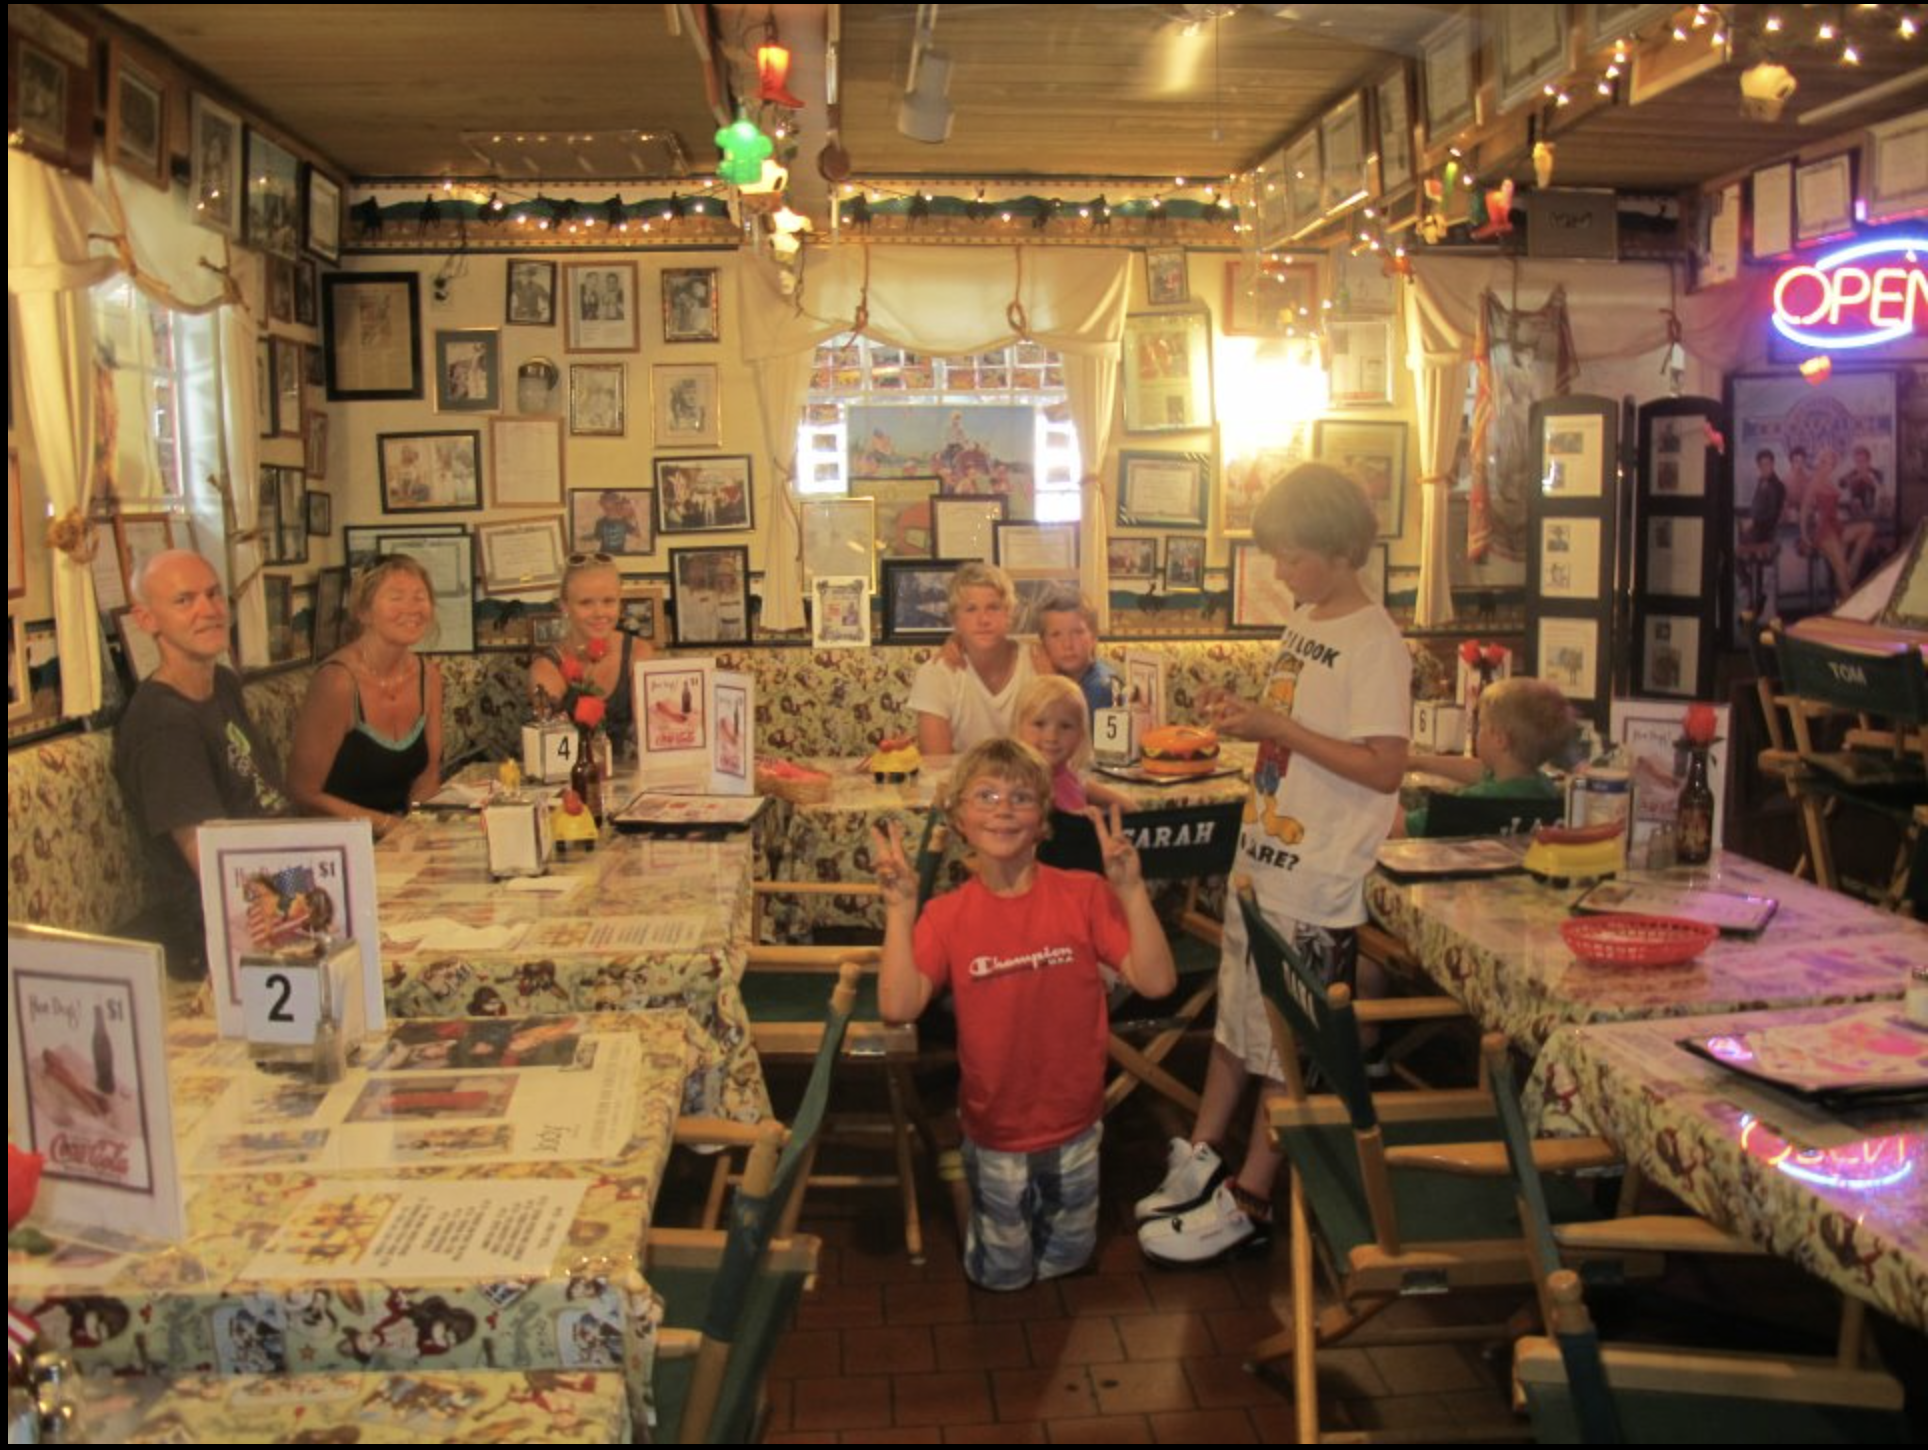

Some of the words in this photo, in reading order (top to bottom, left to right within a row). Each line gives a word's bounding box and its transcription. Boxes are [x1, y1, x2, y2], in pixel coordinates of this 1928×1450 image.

[1773, 265, 1927, 332] OPEN
[1295, 637, 1340, 669] LOOK
[1106, 715, 1117, 740] 5
[1419, 709, 1427, 733] 6
[557, 735, 571, 761] 4
[318, 860, 336, 879] $1
[969, 945, 1073, 977] Champion
[265, 973, 295, 1023] 2
